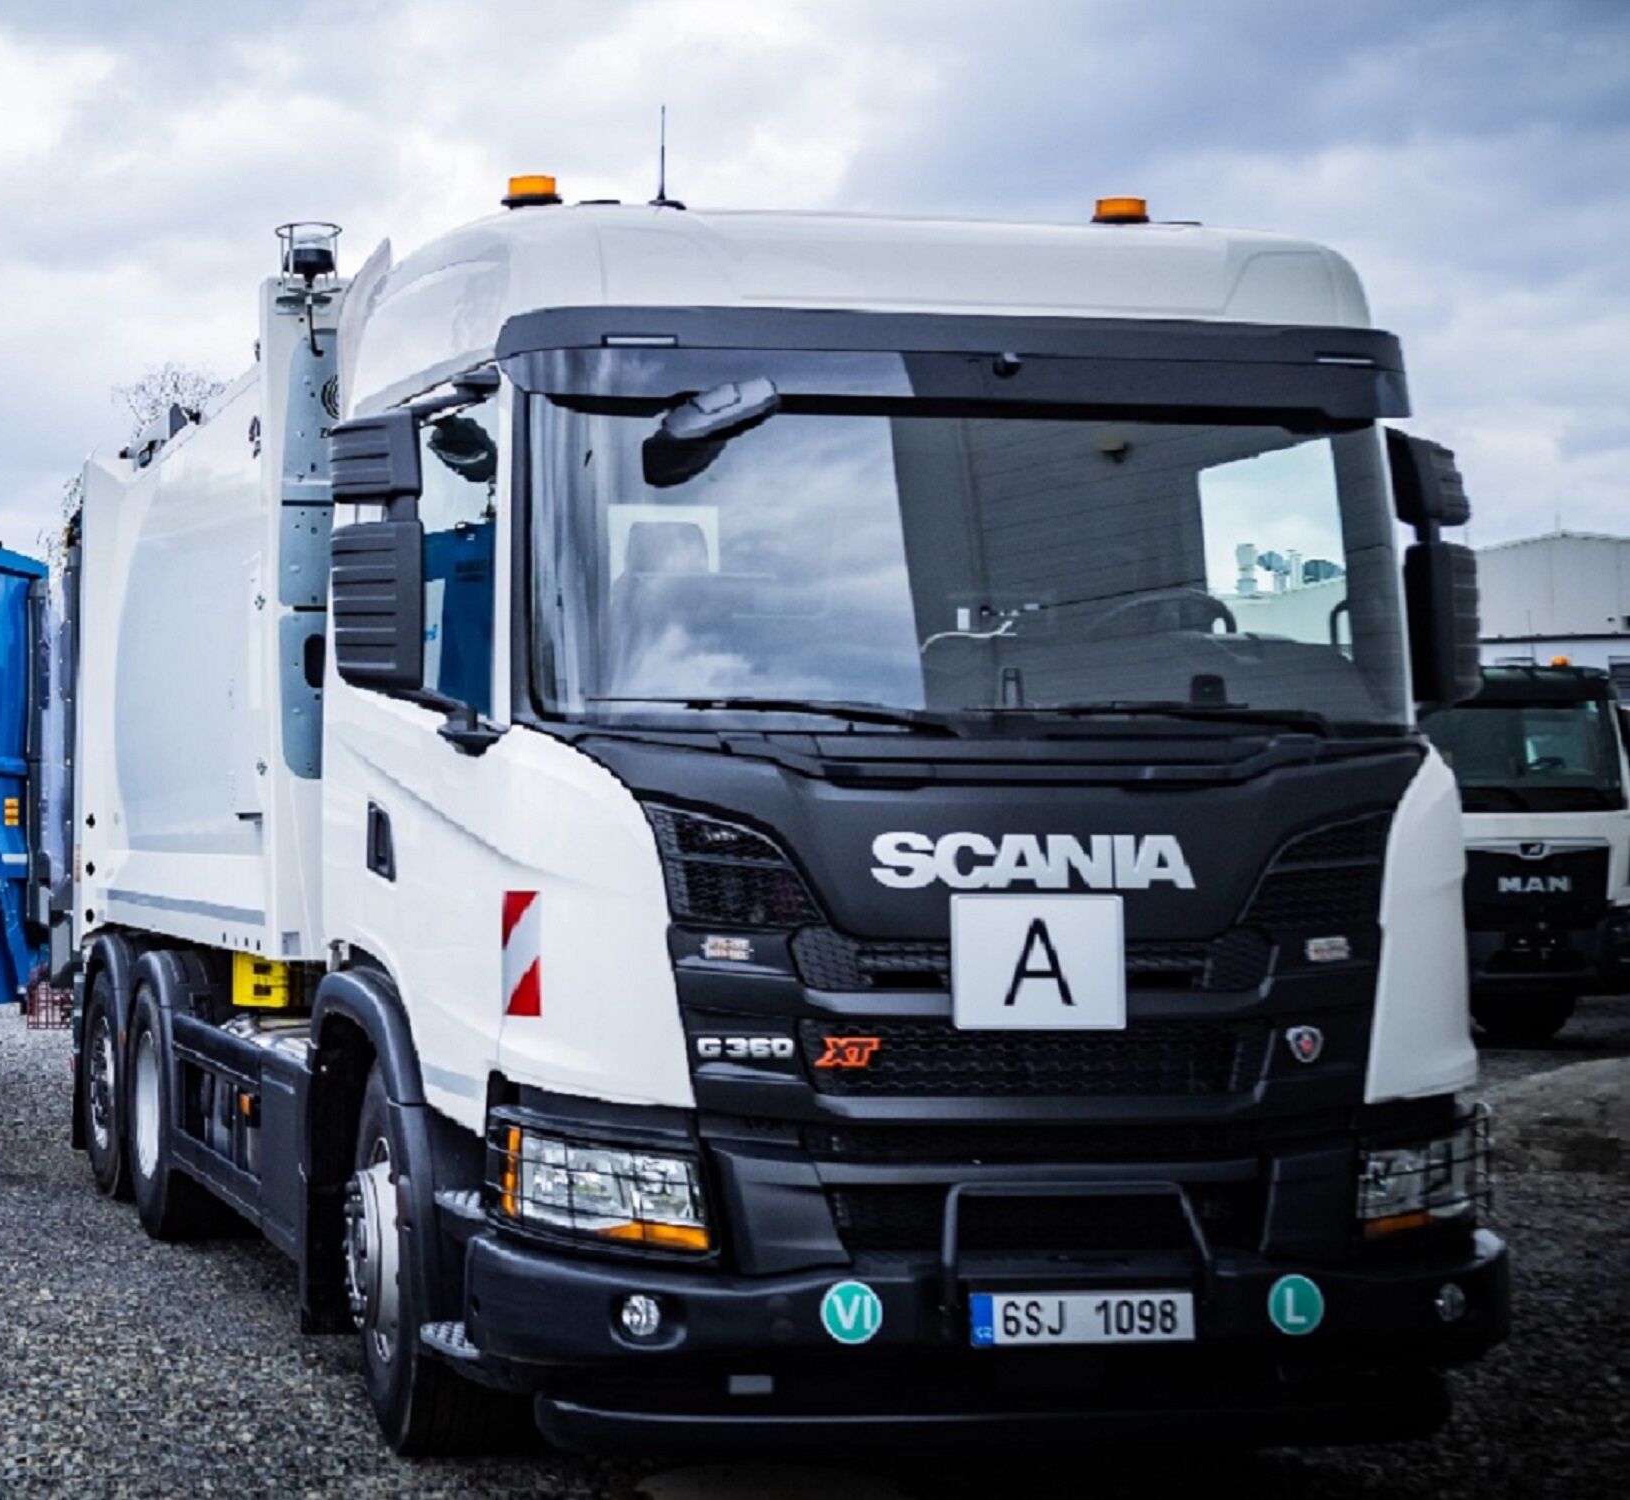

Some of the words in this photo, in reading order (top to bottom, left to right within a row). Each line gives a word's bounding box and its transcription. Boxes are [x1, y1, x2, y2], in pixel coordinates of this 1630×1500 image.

[870, 831, 1197, 889] SCANIA
[1497, 876, 1572, 893] MAN
[1003, 917, 1077, 1007] A
[696, 1037, 722, 1058] G
[725, 1037, 795, 1058] 360
[813, 1036, 882, 1067] XT
[831, 1294, 872, 1330] VI
[1002, 1300, 1067, 1339] 6SJ
[1095, 1299, 1178, 1336] 1098
[1285, 1286, 1308, 1324] L
